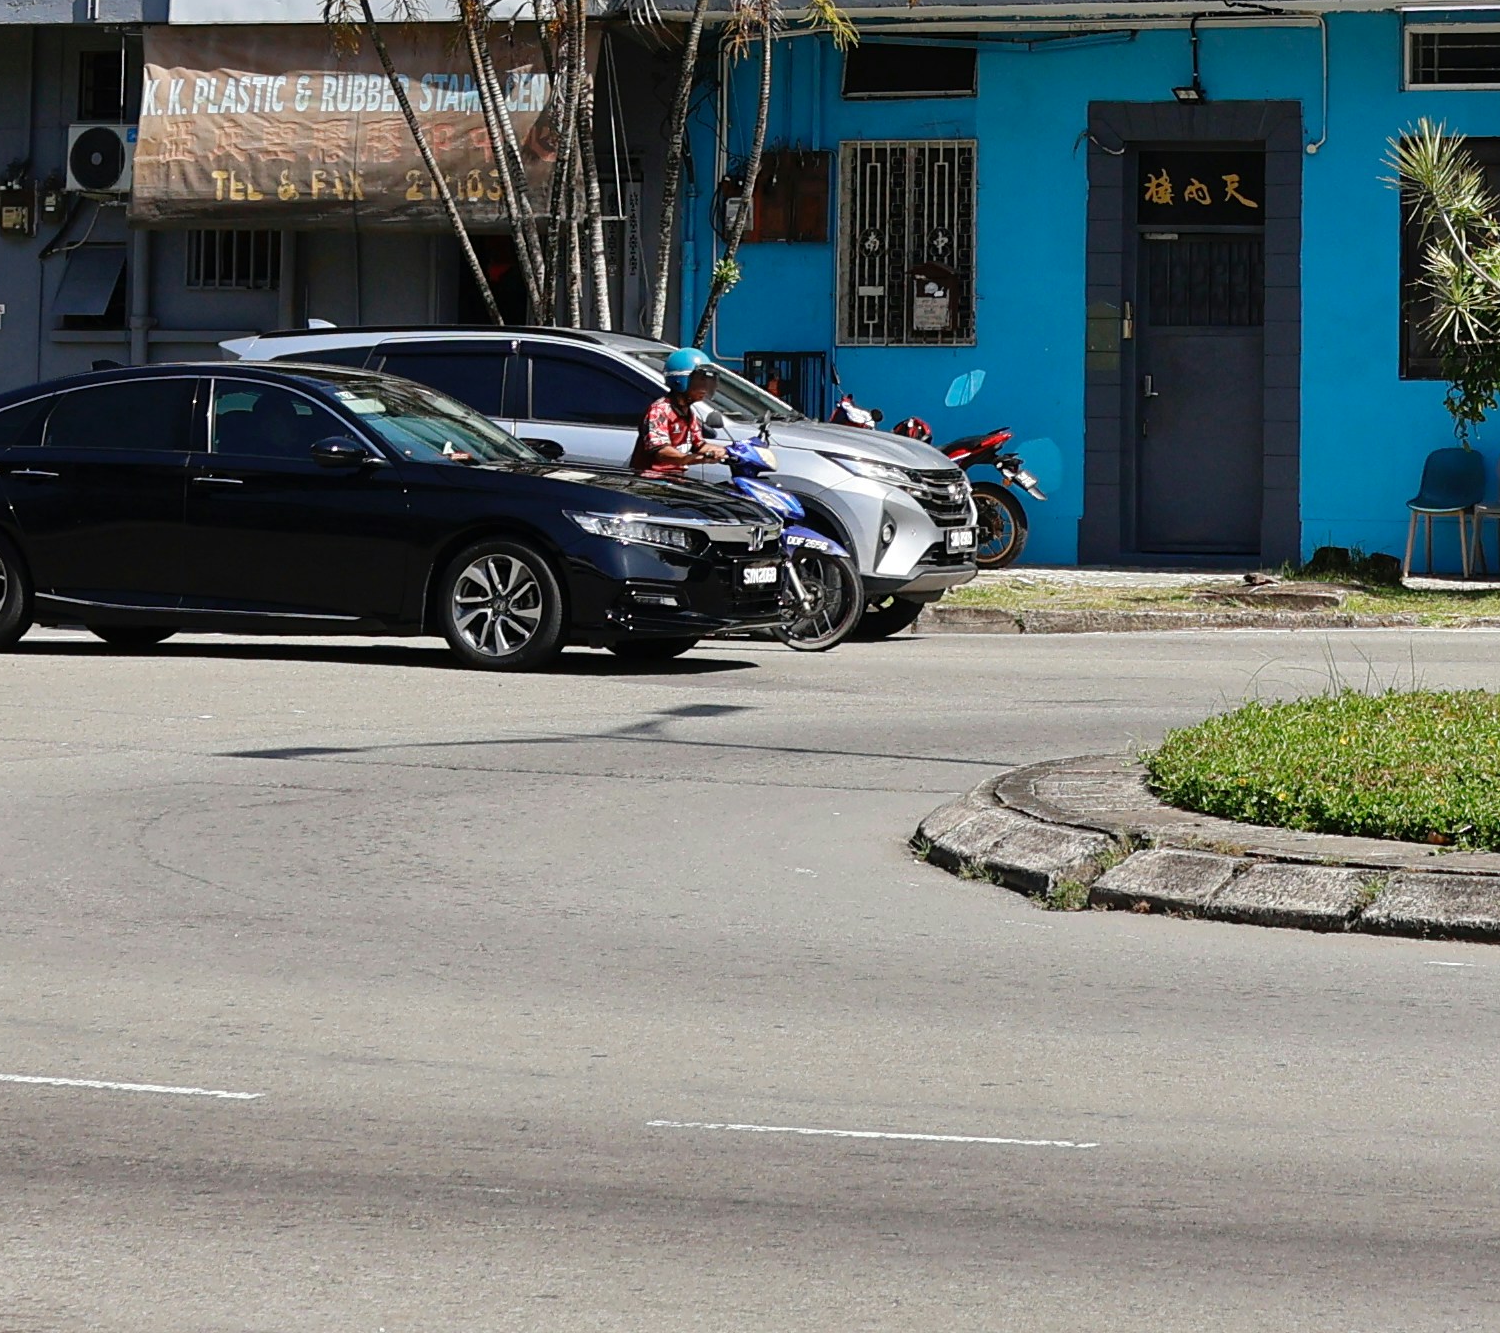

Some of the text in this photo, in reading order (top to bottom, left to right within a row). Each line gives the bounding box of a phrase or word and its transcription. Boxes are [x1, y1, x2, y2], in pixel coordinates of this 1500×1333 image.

[143, 78, 164, 116] K.
[168, 77, 190, 116] K.
[192, 74, 288, 115] PLASTIC
[294, 74, 313, 112] &
[419, 72, 482, 115] STAM
[211, 169, 264, 201] TEL
[277, 168, 300, 201] &
[311, 169, 365, 201] FAX
[933, 231, 948, 254] 中
